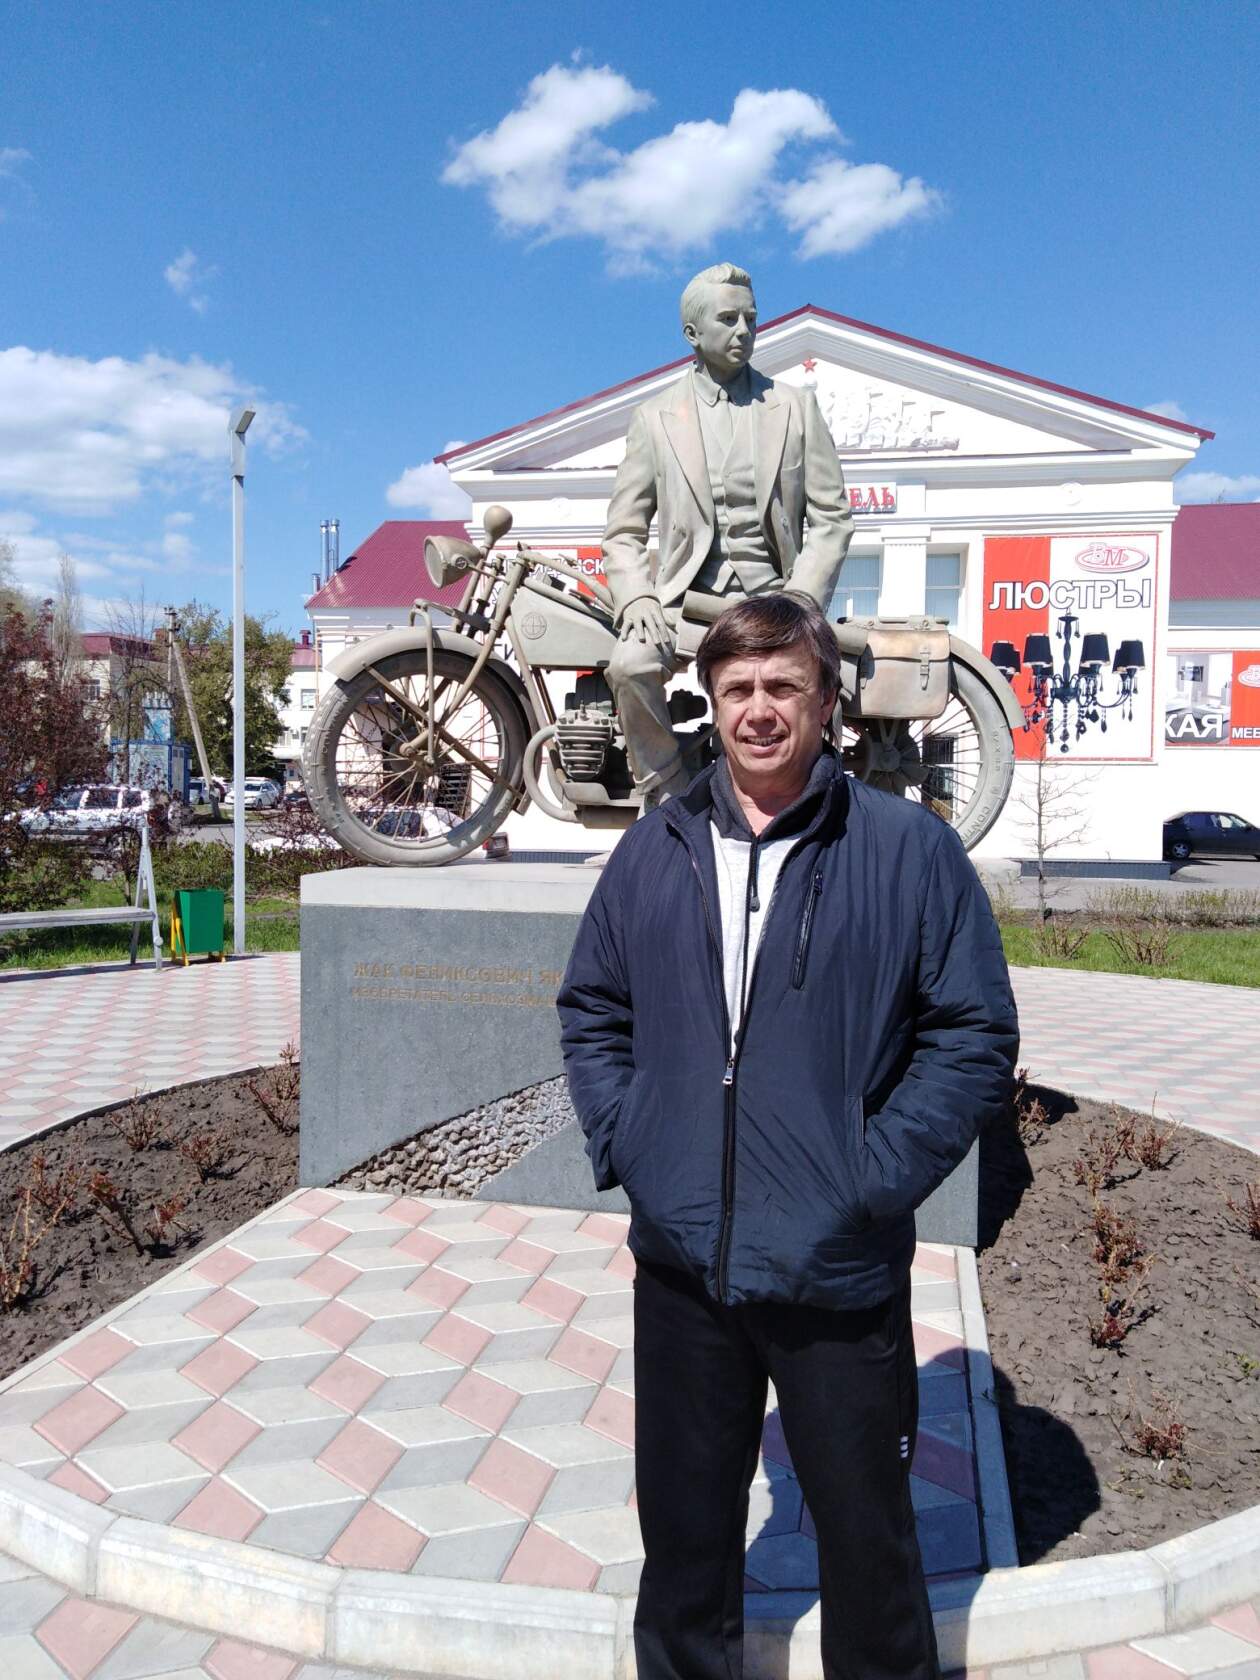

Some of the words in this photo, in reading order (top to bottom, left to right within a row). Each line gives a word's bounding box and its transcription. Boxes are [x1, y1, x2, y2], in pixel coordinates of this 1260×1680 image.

[988, 578, 1151, 610] ЛЮСТРЫ
[354, 961, 393, 978] ЖАК
[400, 964, 533, 985] ФЕЛИКСОВИЧ
